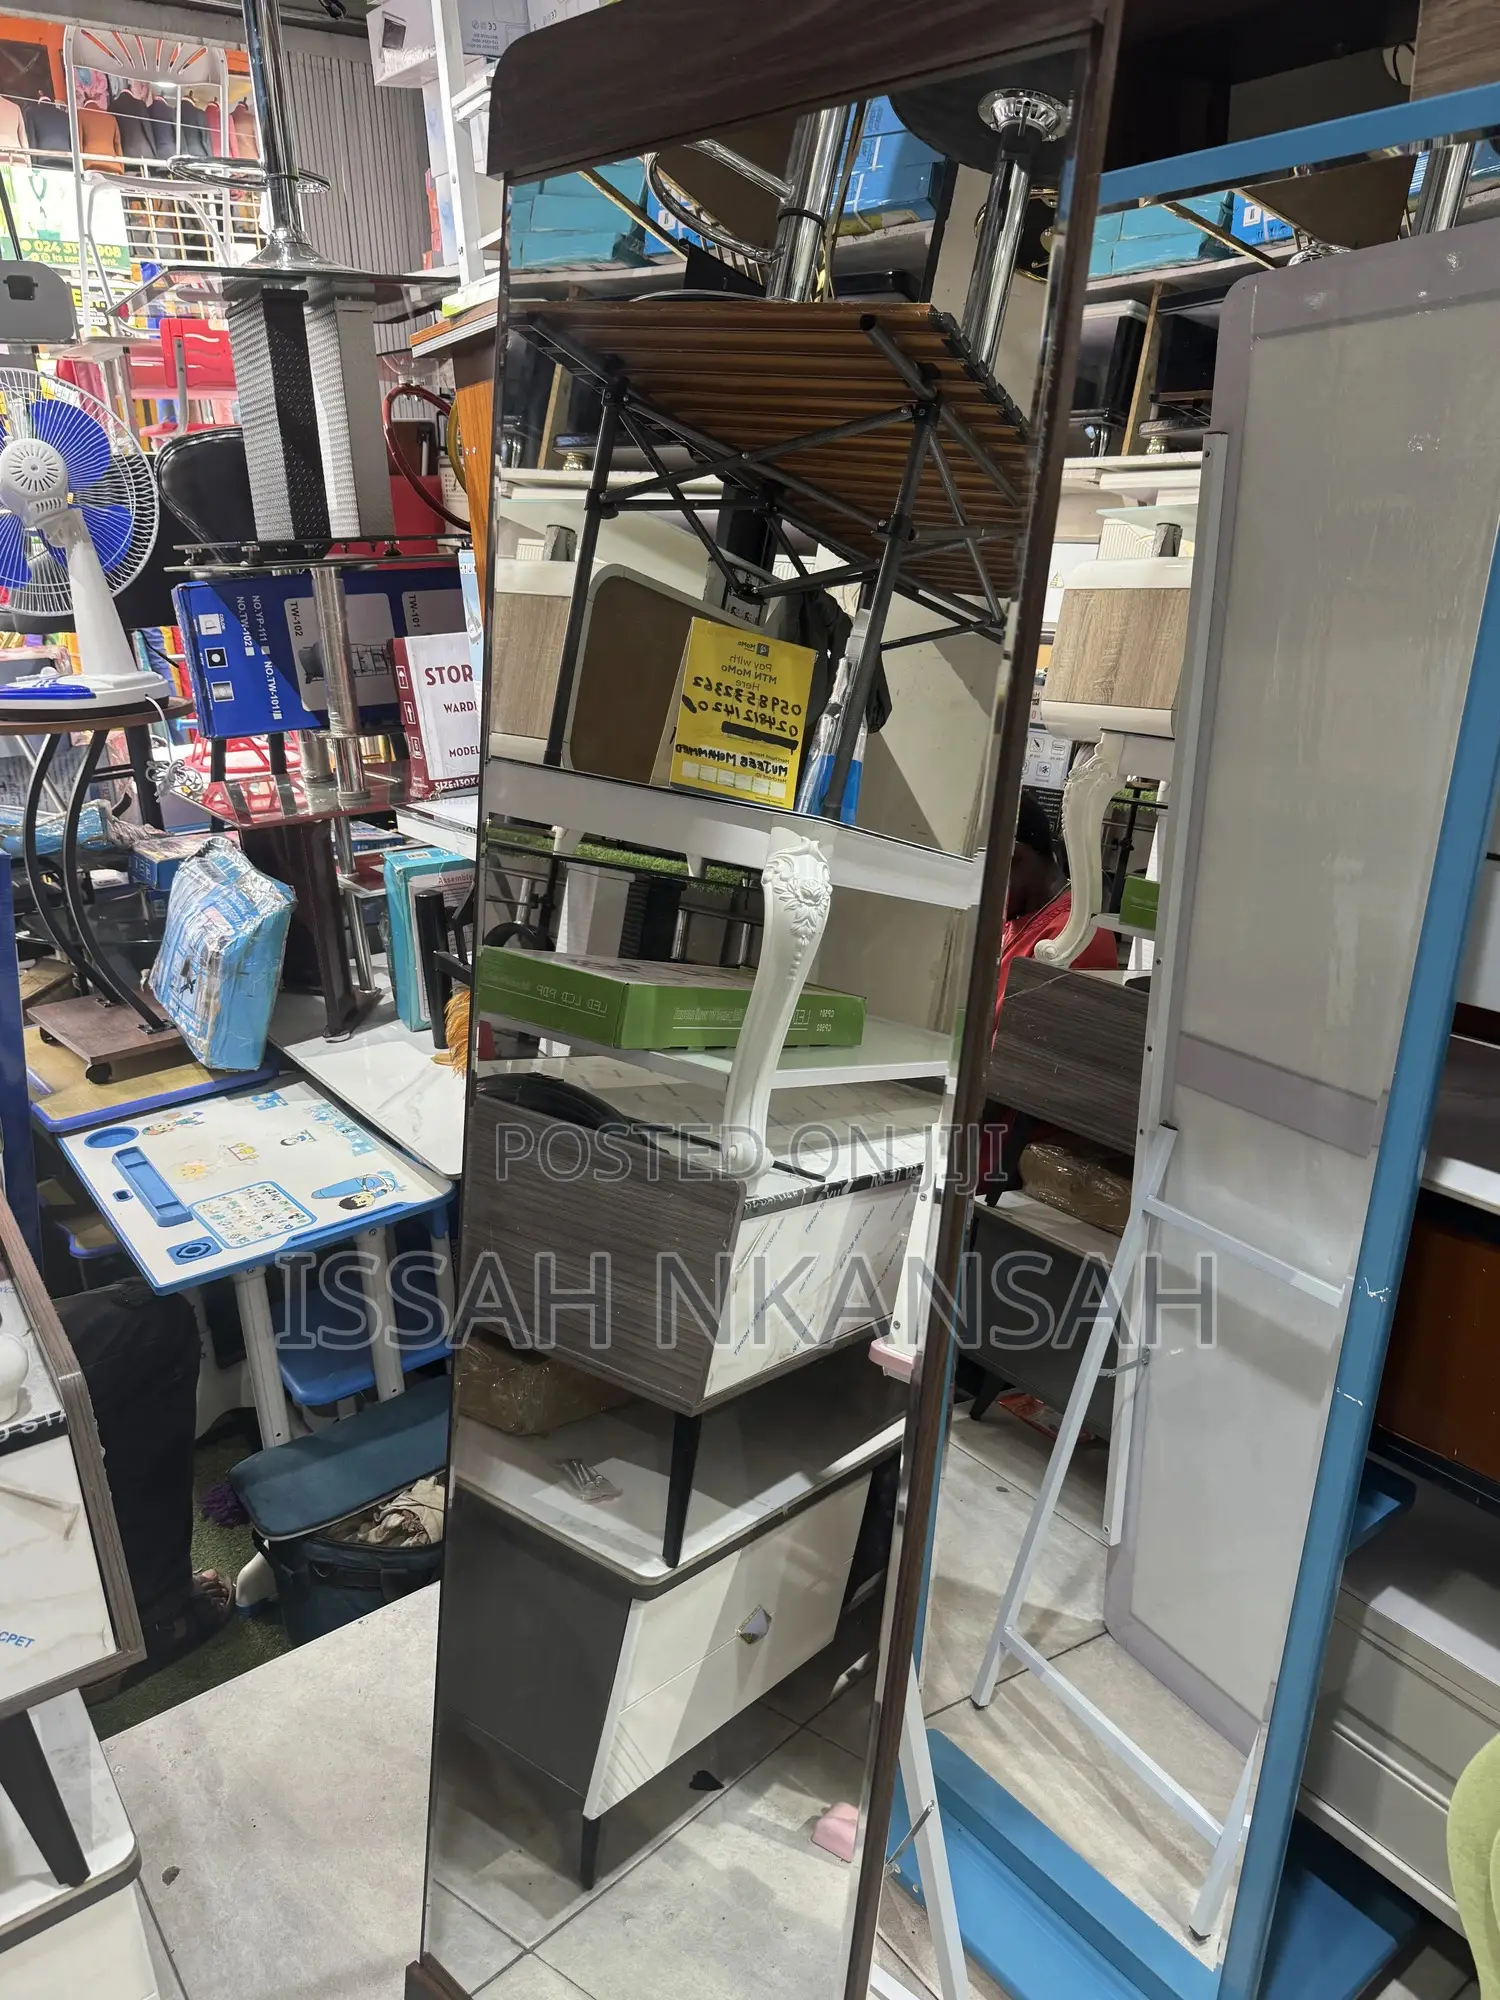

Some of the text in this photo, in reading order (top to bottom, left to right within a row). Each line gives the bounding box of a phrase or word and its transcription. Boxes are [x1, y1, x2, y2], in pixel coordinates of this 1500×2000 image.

[236, 596, 253, 646] NO.TW-102
[252, 595, 268, 642] NO.YP-111
[290, 601, 303, 637] TW-102
[409, 594, 421, 628] TW-101
[264, 661, 281, 711] NO.TW-101
[438, 874, 473, 885] Assembly
